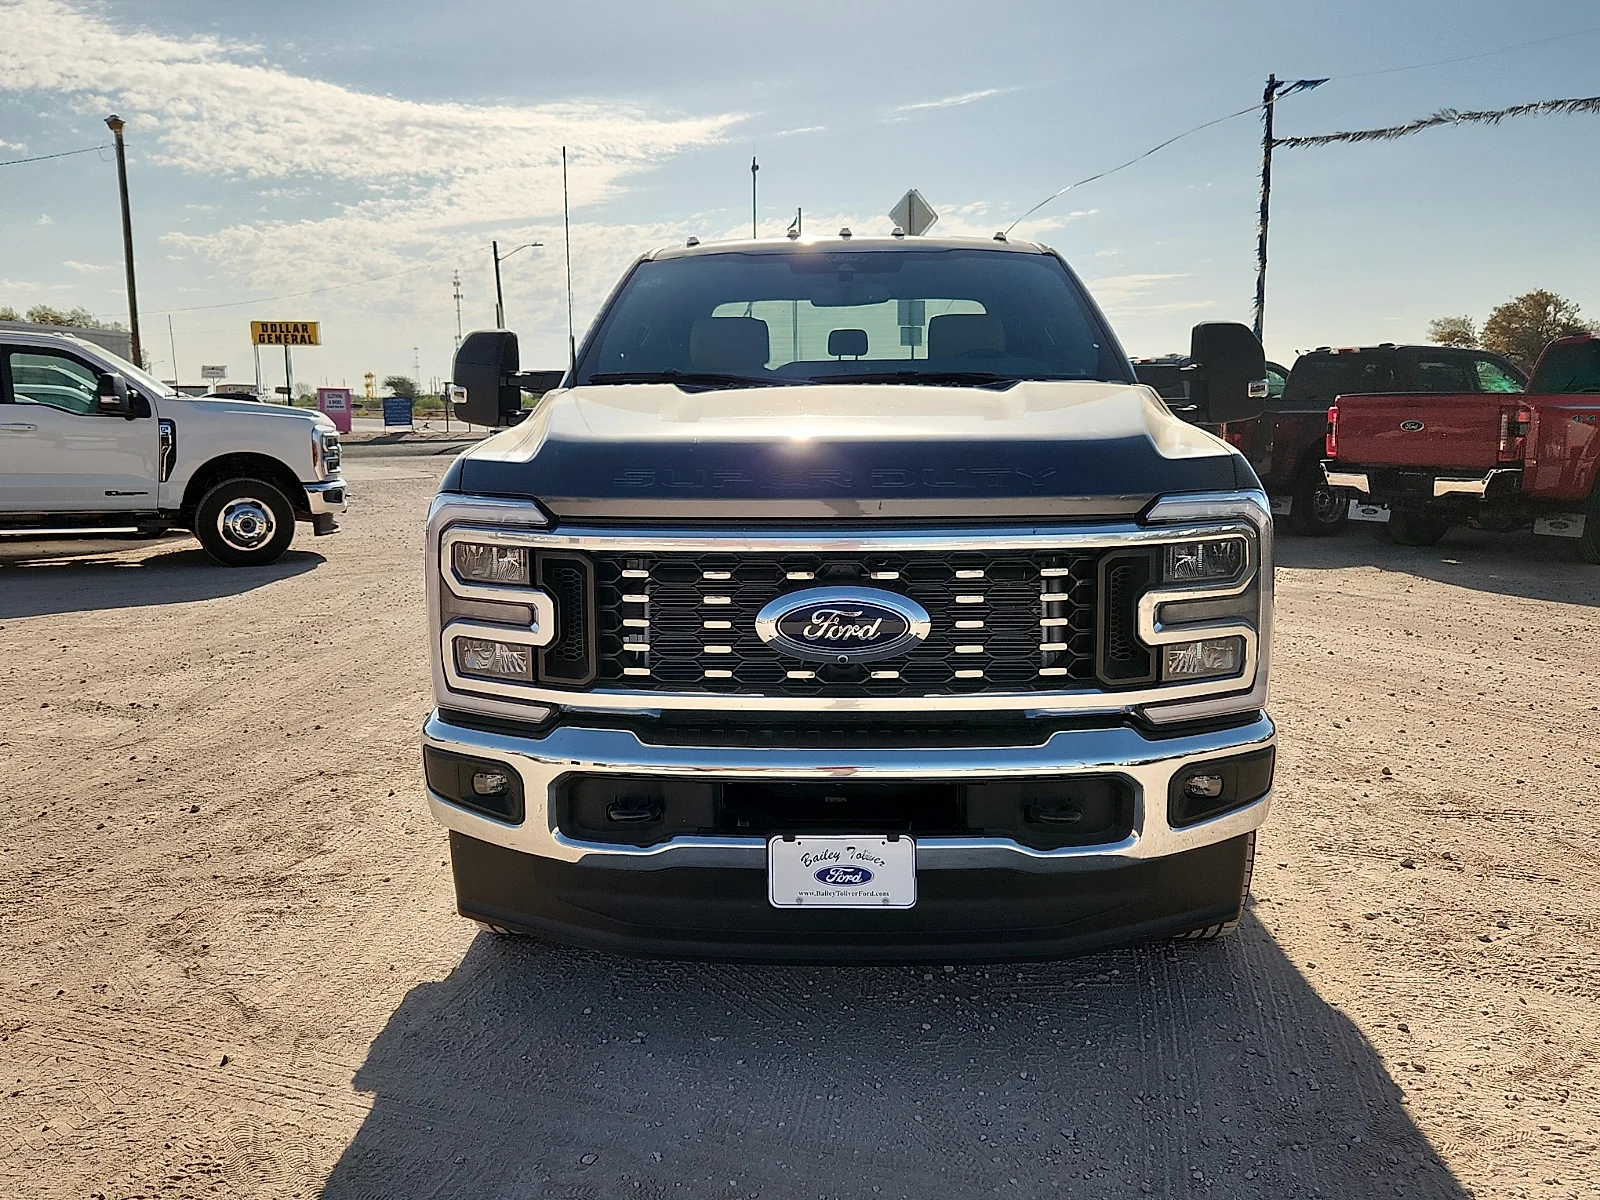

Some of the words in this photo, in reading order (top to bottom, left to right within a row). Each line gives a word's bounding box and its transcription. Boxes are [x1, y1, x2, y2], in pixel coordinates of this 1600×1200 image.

[261, 323, 309, 333] DOLLAR
[258, 334, 314, 344] GENERAL
[612, 468, 853, 488] SUPER
[871, 467, 1056, 488] DUTY
[802, 608, 882, 641] Ford
[800, 848, 842, 868] Bailey
[845, 846, 886, 868] Toliver
[825, 867, 863, 884] Ford
[798, 889, 890, 898] www.BaileyToliverFord.com
